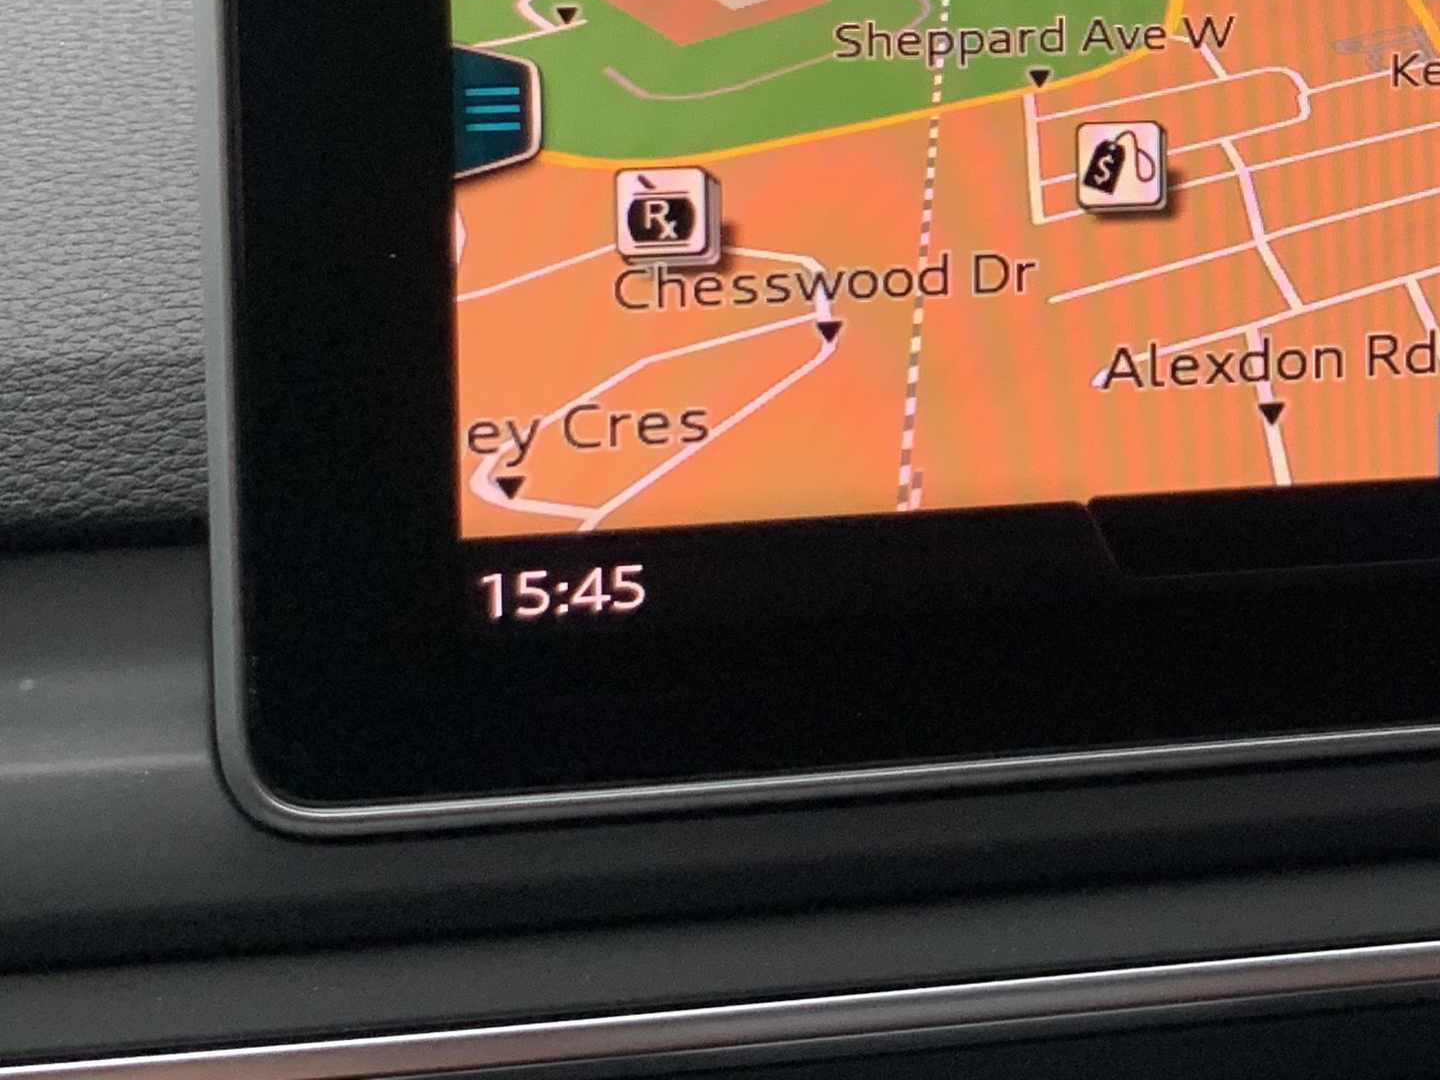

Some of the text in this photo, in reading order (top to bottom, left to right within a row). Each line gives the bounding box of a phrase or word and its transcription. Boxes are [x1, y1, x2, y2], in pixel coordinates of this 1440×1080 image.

[834, 16, 1235, 67] Sheppard Ave W
[614, 251, 1038, 310] Chesswood Dr
[1102, 332, 1438, 390] Alexdon Rd
[466, 403, 710, 468] ey Cres
[480, 564, 647, 618] 15:45
